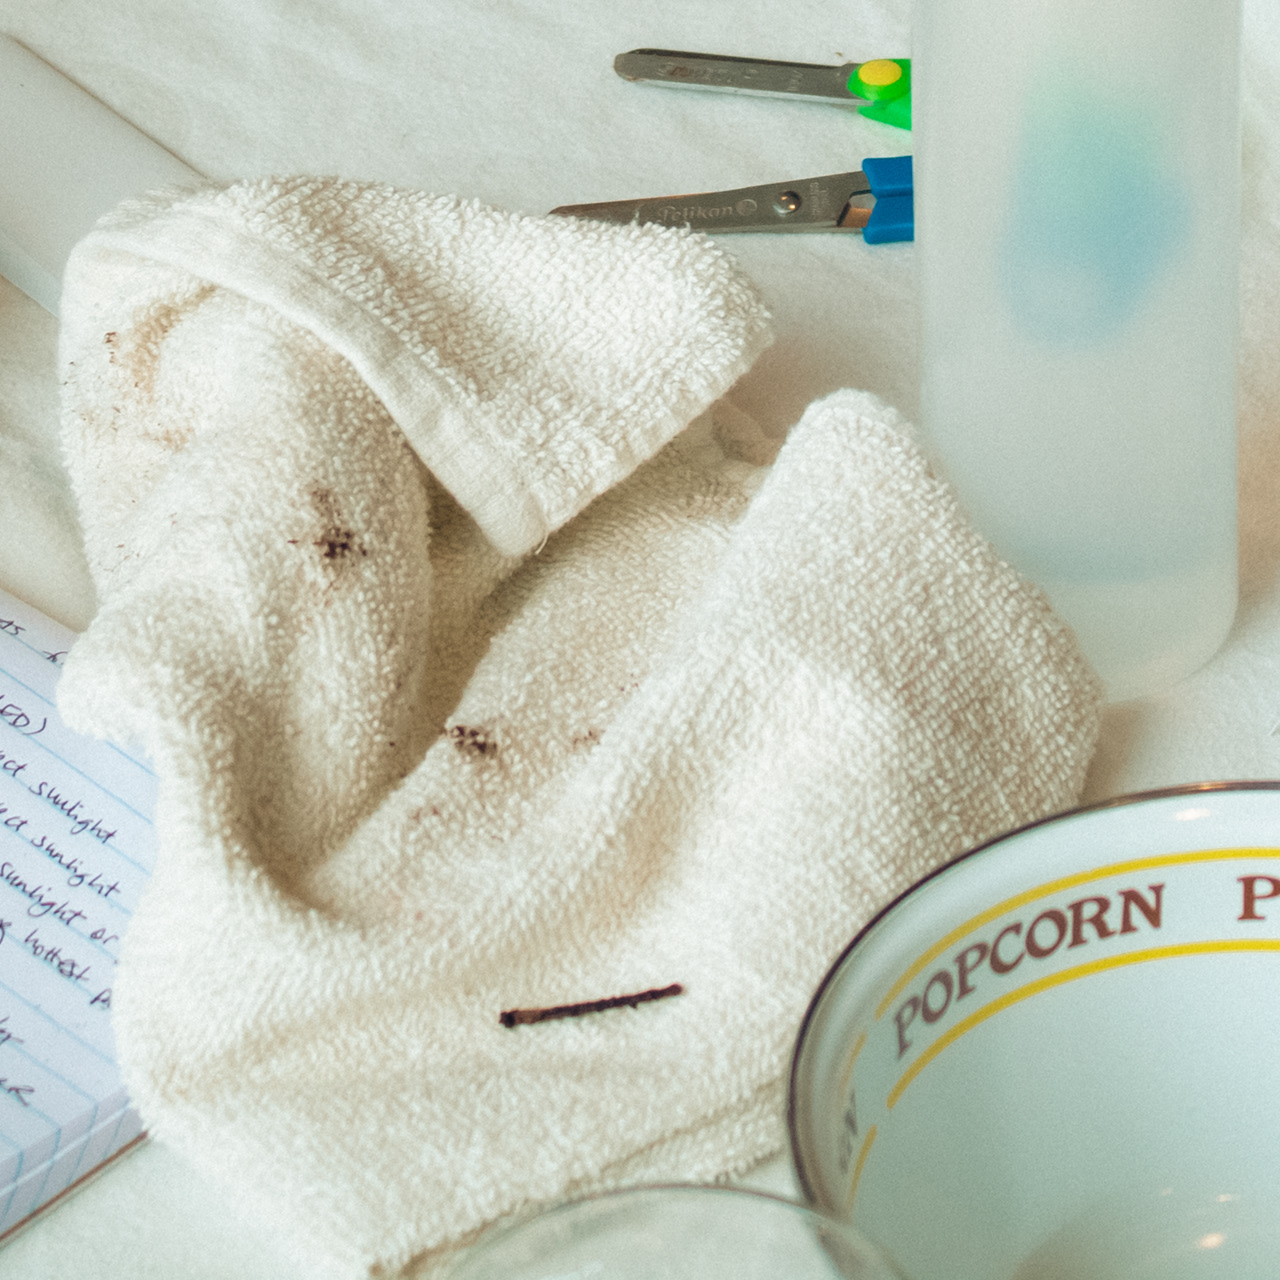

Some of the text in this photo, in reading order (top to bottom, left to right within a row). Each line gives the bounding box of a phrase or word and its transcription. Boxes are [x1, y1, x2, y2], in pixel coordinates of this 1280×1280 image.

[28, 781, 120, 845] sunlight
[30, 827, 122, 899] sunlight
[89, 927, 119, 945] or
[893, 882, 1166, 1060] POPCORN
